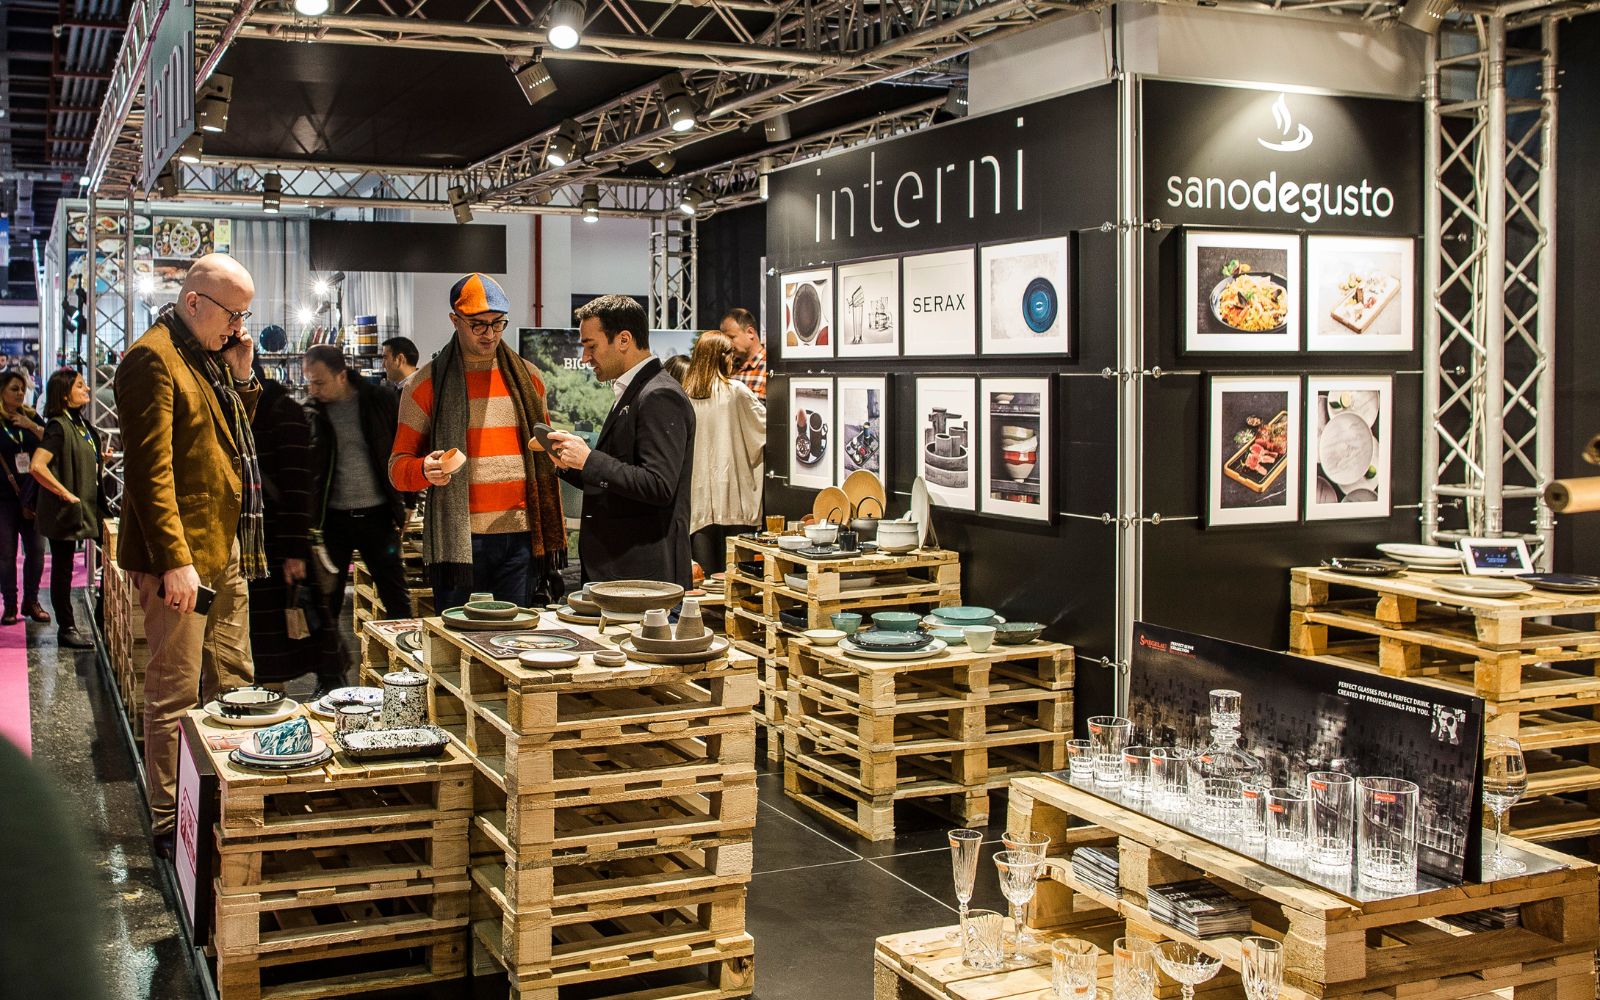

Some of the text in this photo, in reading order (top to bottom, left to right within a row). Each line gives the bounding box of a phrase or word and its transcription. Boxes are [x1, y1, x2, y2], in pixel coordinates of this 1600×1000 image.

[815, 116, 1025, 243] interni
[1167, 171, 1394, 224] sanodegusto
[913, 293, 966, 313] SERAX
[1337, 689, 1430, 716] CREATED BY PROFESSIONALS FOR YOU.
[1338, 681, 1358, 691] PERFECT
[1358, 685, 1377, 696] GLASSES
[1378, 690, 1388, 698] FOR
[1393, 694, 1413, 703] PERFECT
[1413, 699, 1431, 708] DRINK.
